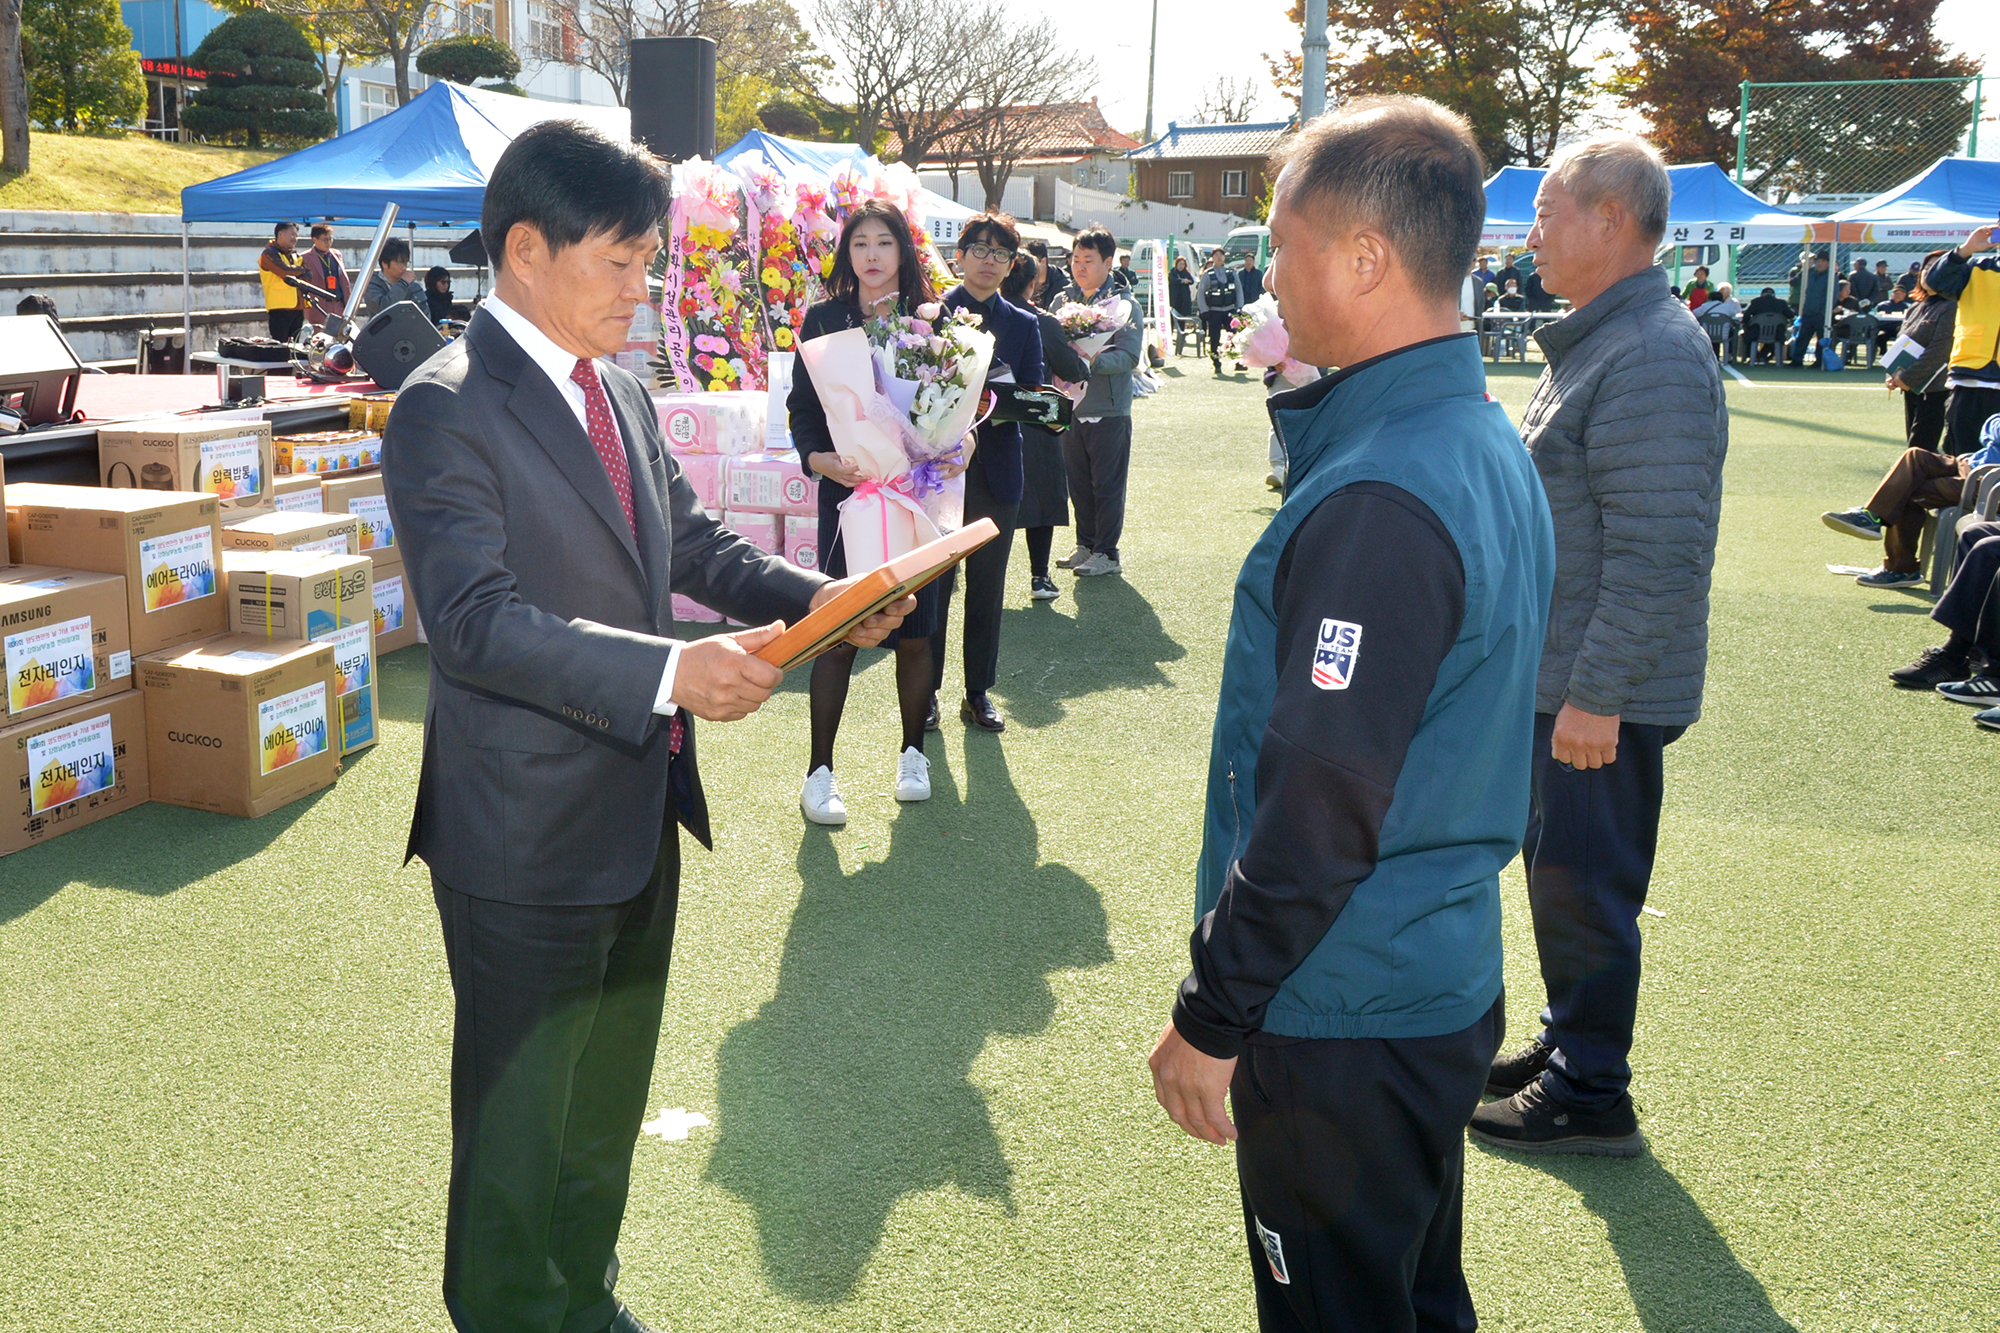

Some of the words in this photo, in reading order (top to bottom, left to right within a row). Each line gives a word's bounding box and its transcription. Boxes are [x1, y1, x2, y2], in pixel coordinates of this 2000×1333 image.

[238, 428, 269, 438] CUCKOO
[674, 420, 681, 436] 나라
[681, 416, 690, 440] 깨끗한
[142, 438, 174, 448] CUCKOO
[213, 465, 251, 484] 압력밥통
[789, 484, 796, 496] 나라
[327, 524, 357, 537] CUCKOO
[361, 520, 384, 535] 청소기
[234, 538, 269, 548] CUCKOO
[146, 559, 211, 588] 에어프라이어
[1320, 623, 1356, 648] US
[1330, 645, 1353, 654] TEAM
[18, 653, 86, 688] 전자레인지
[167, 731, 222, 749] CUCKOO
[264, 715, 324, 751] 에어프라이어
[40, 751, 105, 789] 전자레인지
